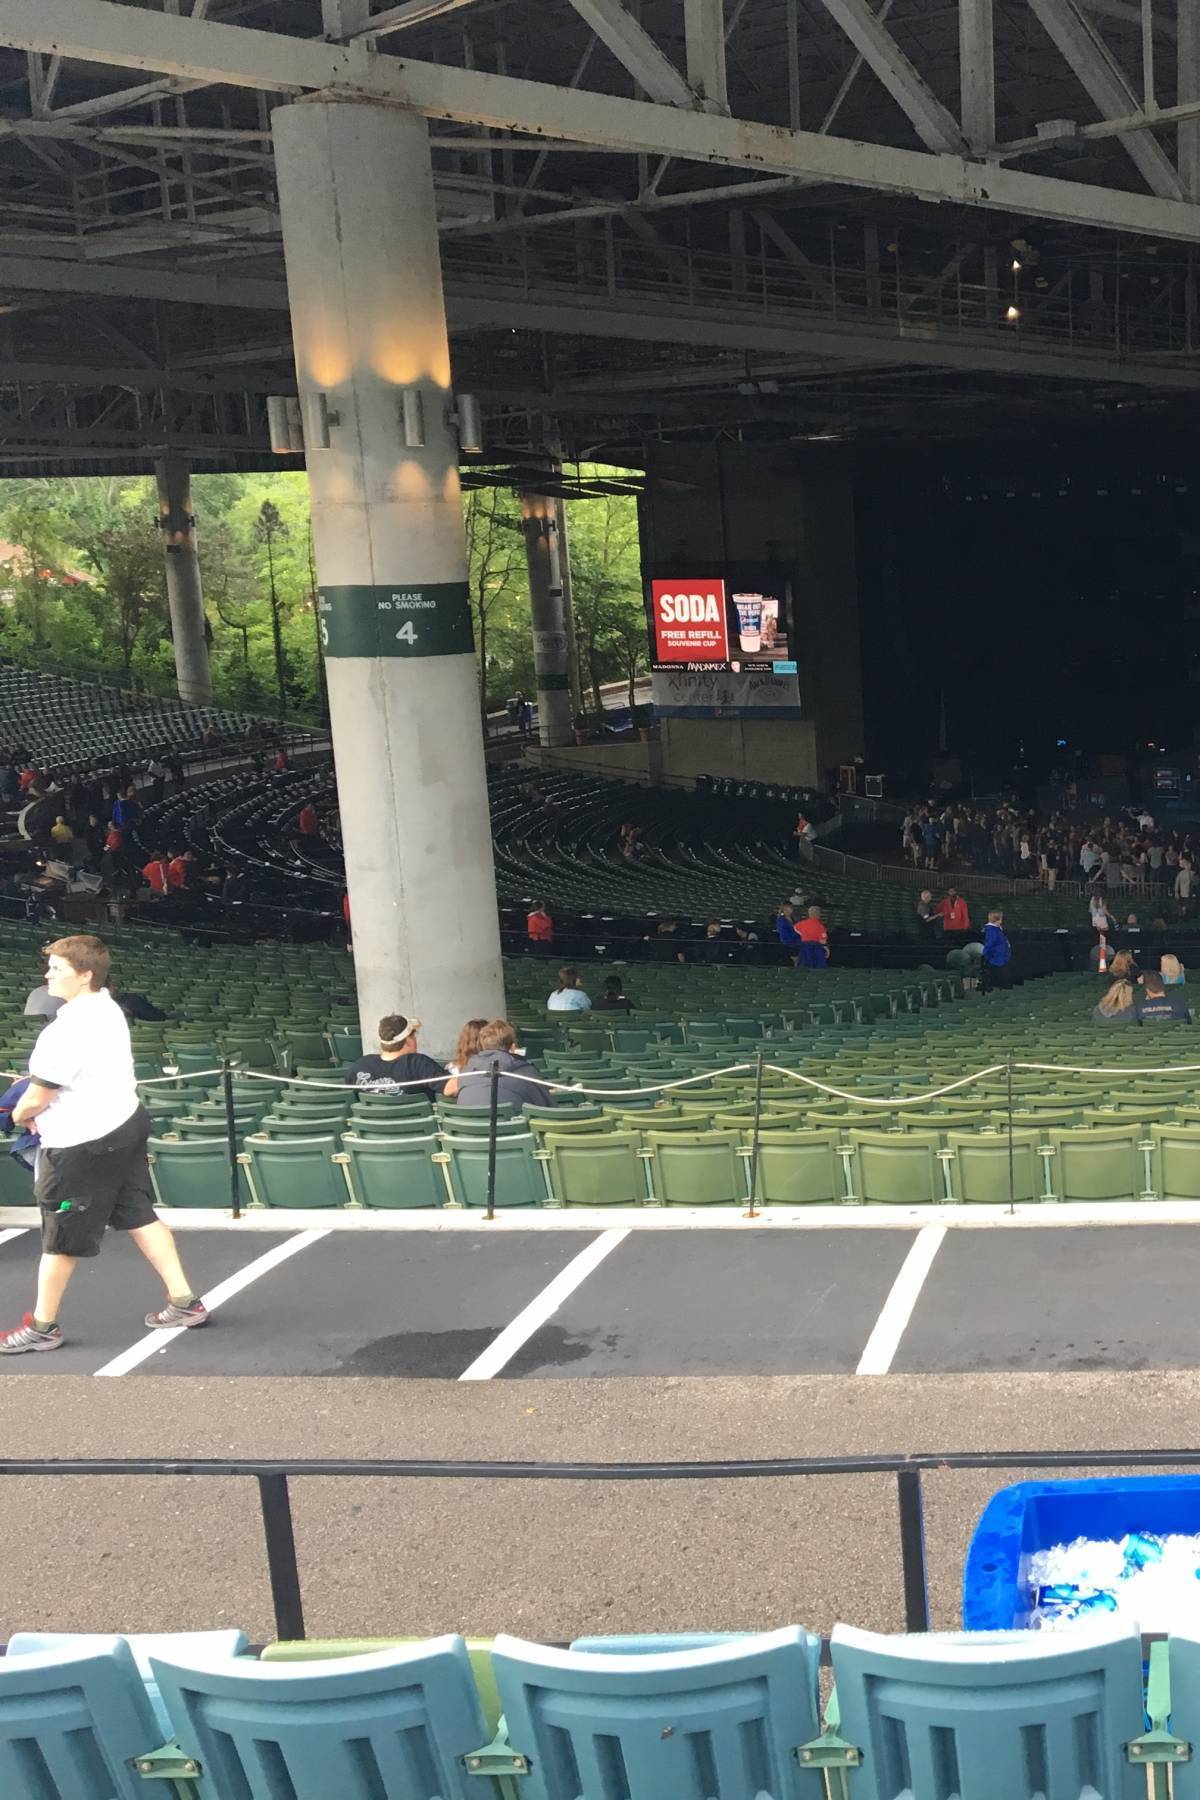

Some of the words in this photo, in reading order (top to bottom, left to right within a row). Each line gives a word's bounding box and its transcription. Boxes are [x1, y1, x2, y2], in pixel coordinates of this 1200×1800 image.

[392, 593, 422, 602] PLEASE
[378, 601, 392, 610] NO
[395, 600, 436, 609] SMOKING
[659, 593, 720, 623] SODA
[395, 620, 418, 645] 4
[661, 630, 687, 639] FREE
[688, 630, 722, 639] REFILL
[668, 673, 718, 690] xfinity
